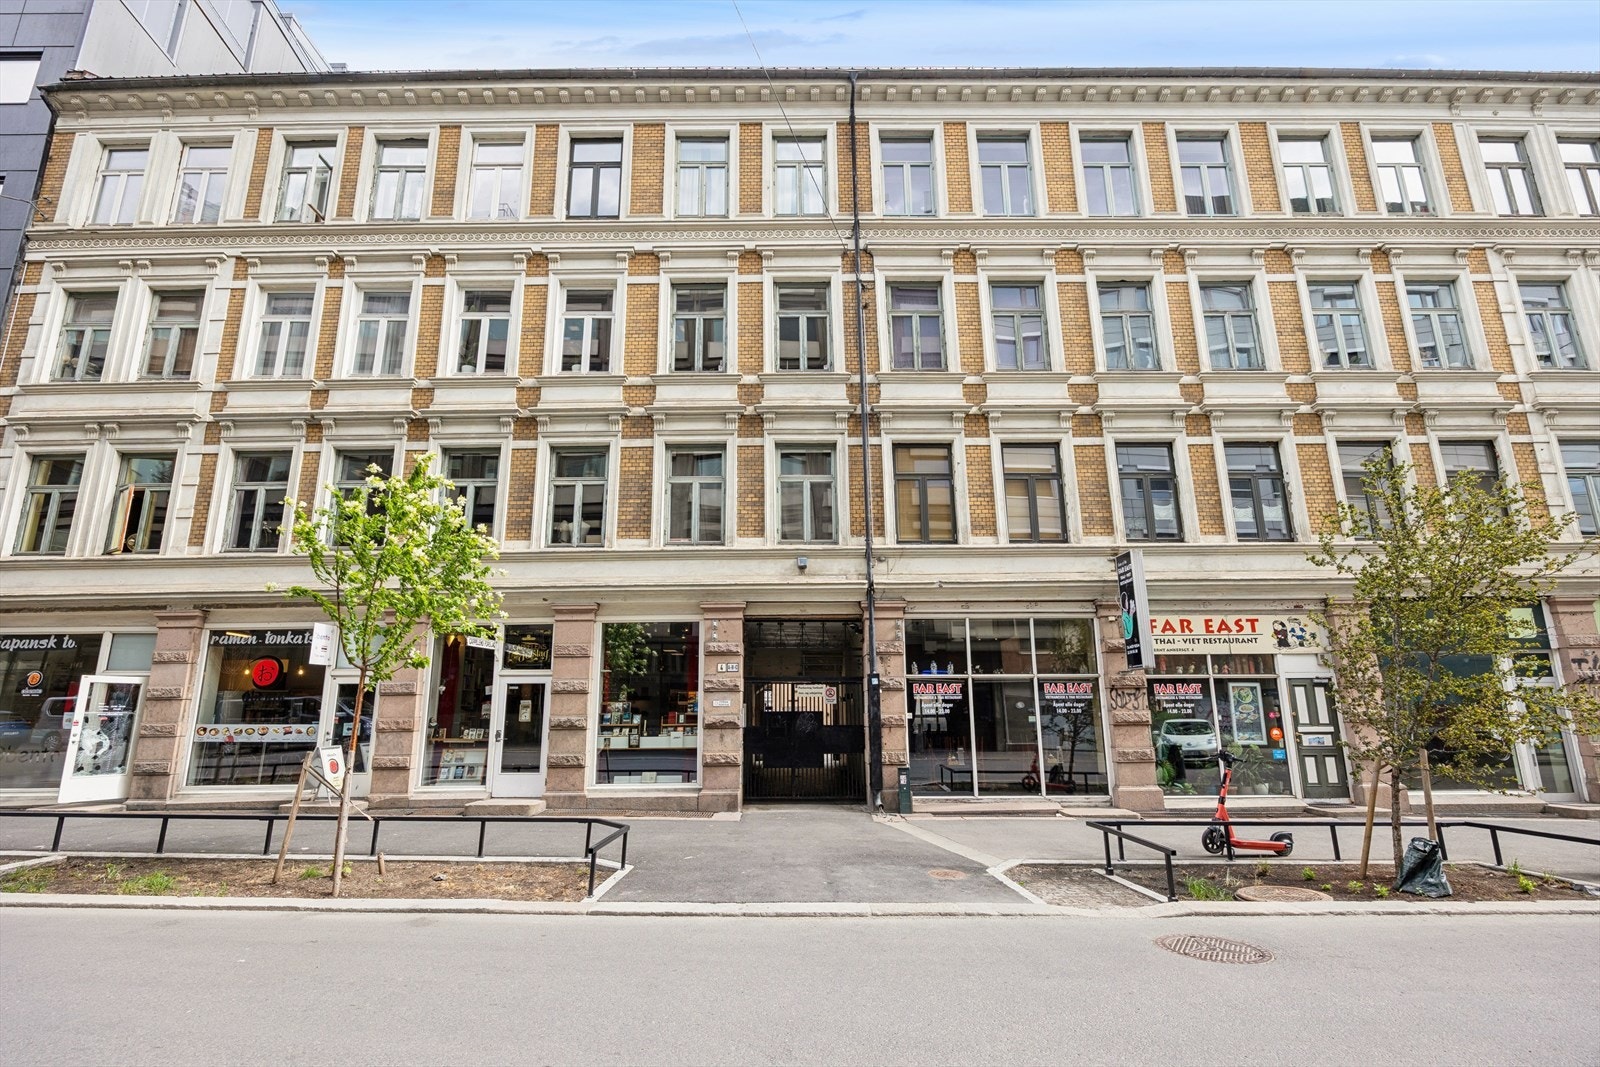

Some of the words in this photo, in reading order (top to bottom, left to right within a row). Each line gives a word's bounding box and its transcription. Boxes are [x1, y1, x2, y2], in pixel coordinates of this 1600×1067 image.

[1150, 618, 1193, 634] FAR
[1204, 618, 1259, 633] EAST
[210, 634, 257, 645] ramen
[1203, 637, 1259, 645] RESTAURANT
[913, 683, 935, 694] FAR
[936, 683, 962, 694] EAST
[1043, 682, 1066, 694] FAR
[1066, 682, 1093, 694] EAST
[1153, 683, 1175, 694] FAR
[1175, 683, 1202, 694] EAST
